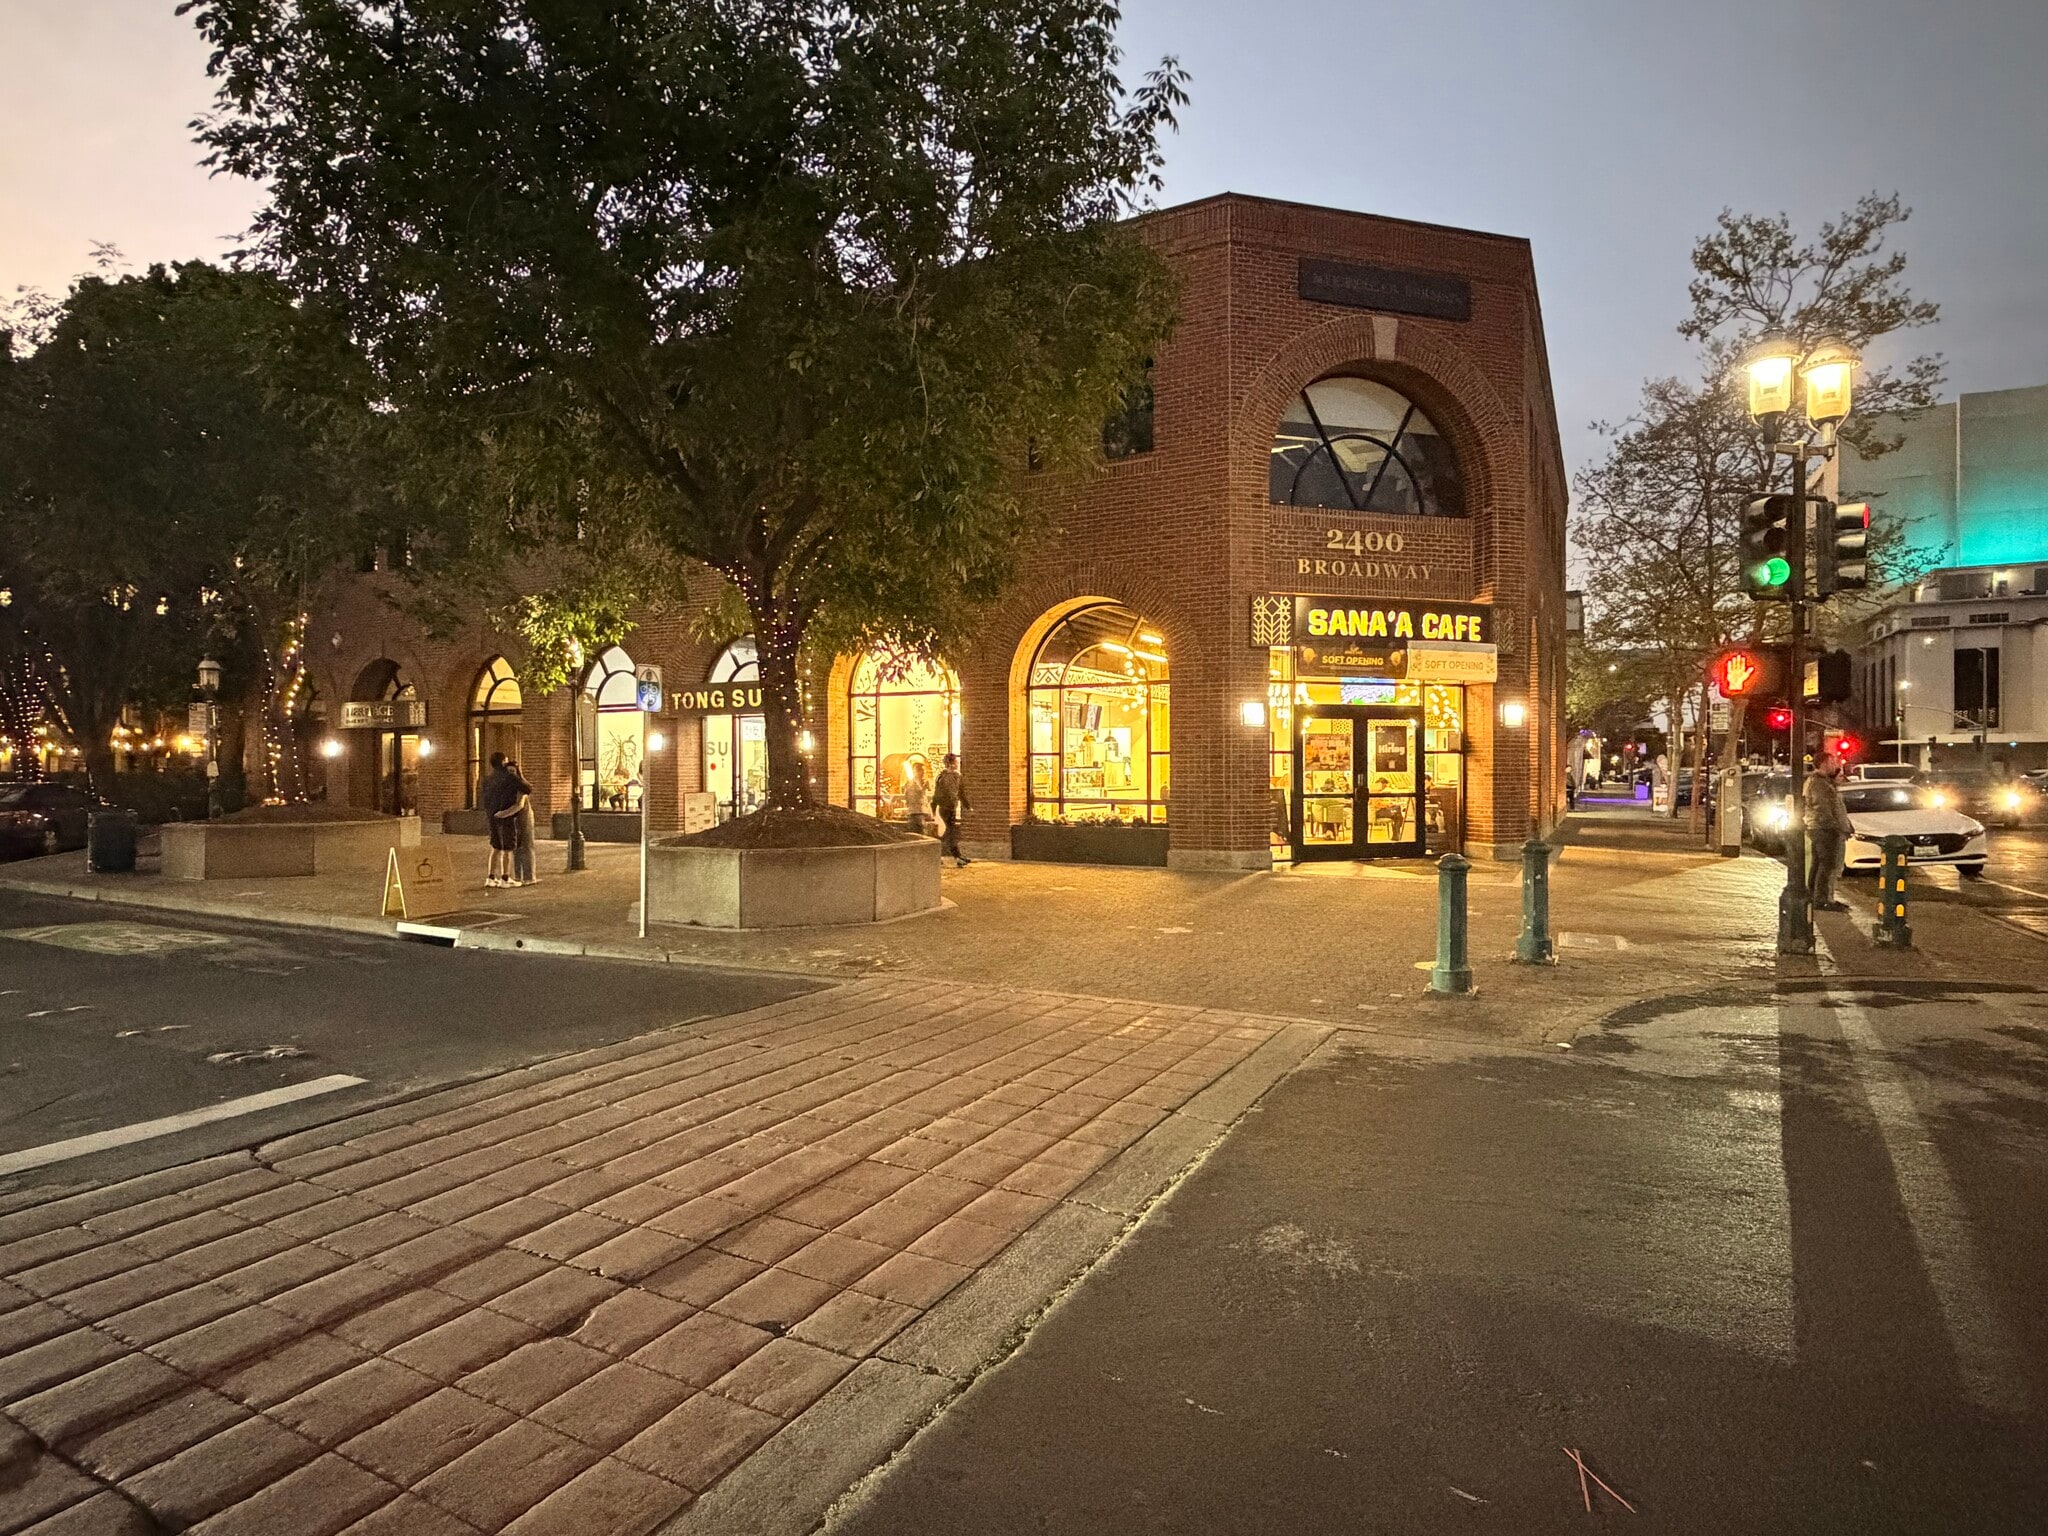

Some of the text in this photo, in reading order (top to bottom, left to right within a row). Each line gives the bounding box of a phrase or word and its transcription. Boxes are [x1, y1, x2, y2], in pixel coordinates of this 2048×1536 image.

[1327, 529, 1403, 556] 2400
[1298, 558, 1433, 579] BROADWAY
[1308, 609, 1482, 642] SANA'A CAFE
[1322, 655, 1384, 667] SOFT OPENING
[1424, 659, 1485, 671] SOFT OPENING
[671, 690, 725, 710] TONG
